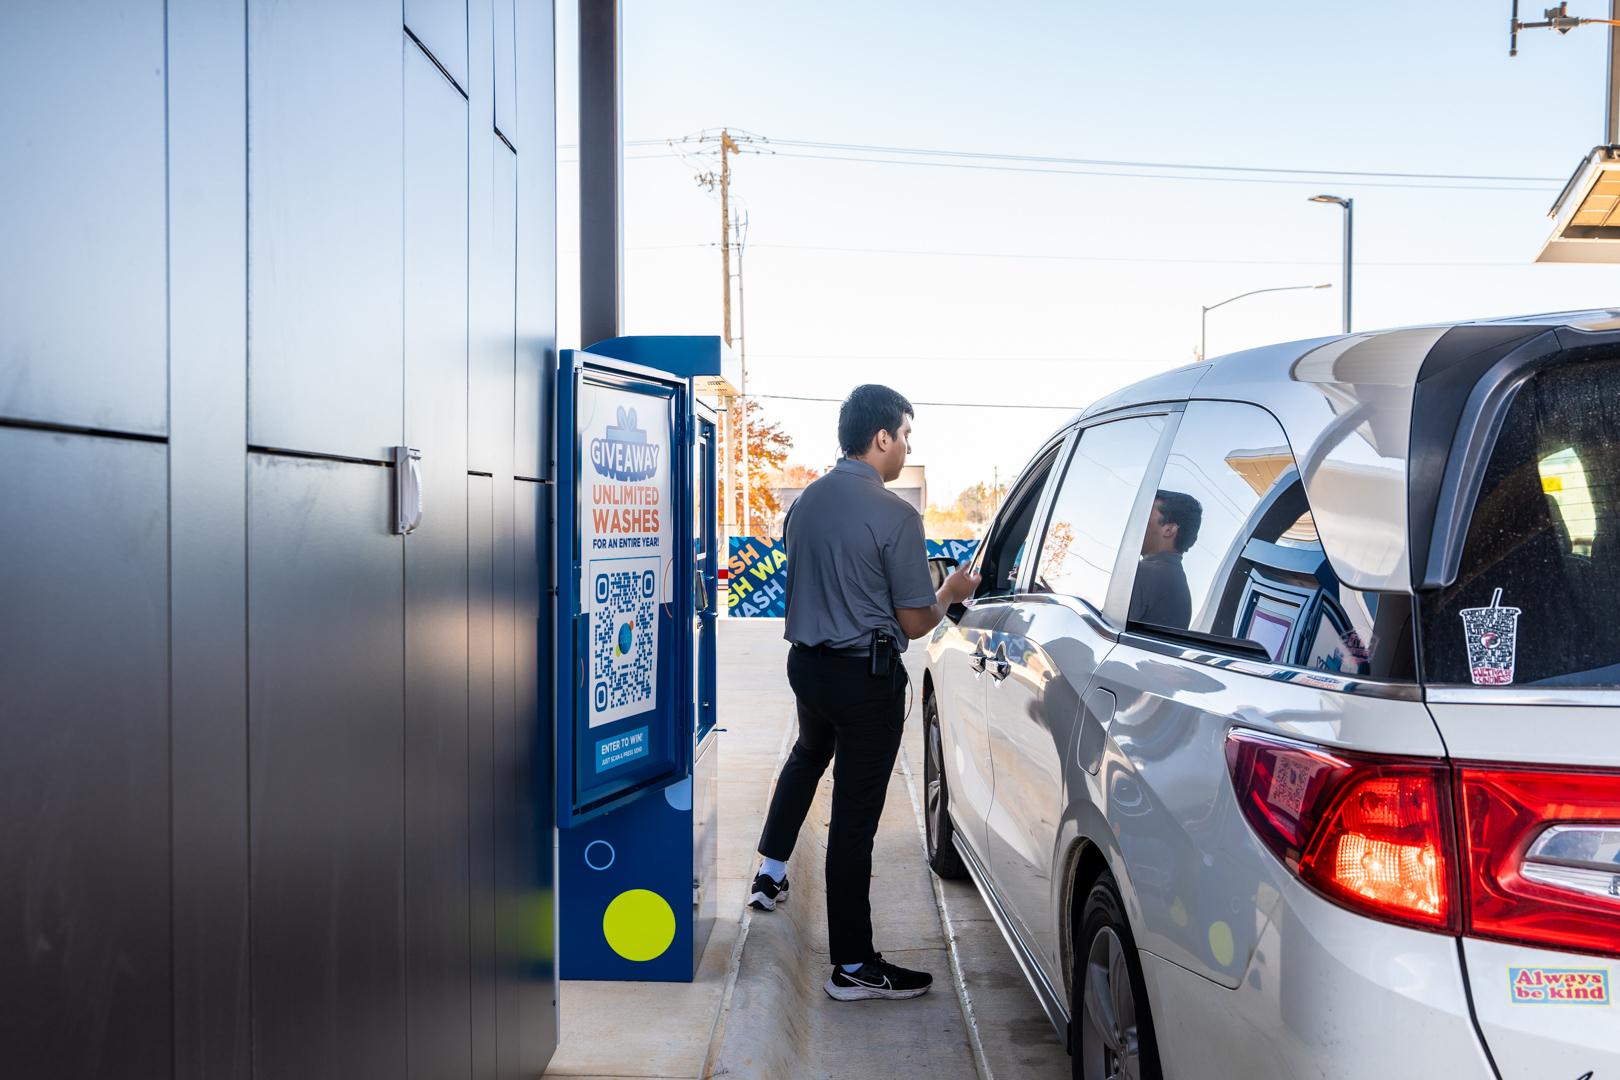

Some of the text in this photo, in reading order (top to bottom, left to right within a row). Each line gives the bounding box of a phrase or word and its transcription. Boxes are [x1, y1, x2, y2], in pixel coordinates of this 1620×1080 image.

[591, 439, 659, 474] GIVEAWAY
[592, 484, 659, 505] UNLIMITED
[592, 508, 660, 534] WASHES
[593, 537, 660, 549] FOR AN ENTIRE YEAR!
[601, 732, 643, 755] ENTER TO WIN!
[601, 757, 611, 765] JUST
[1515, 969, 1602, 986] Always
[1514, 983, 1606, 1000] be kind
